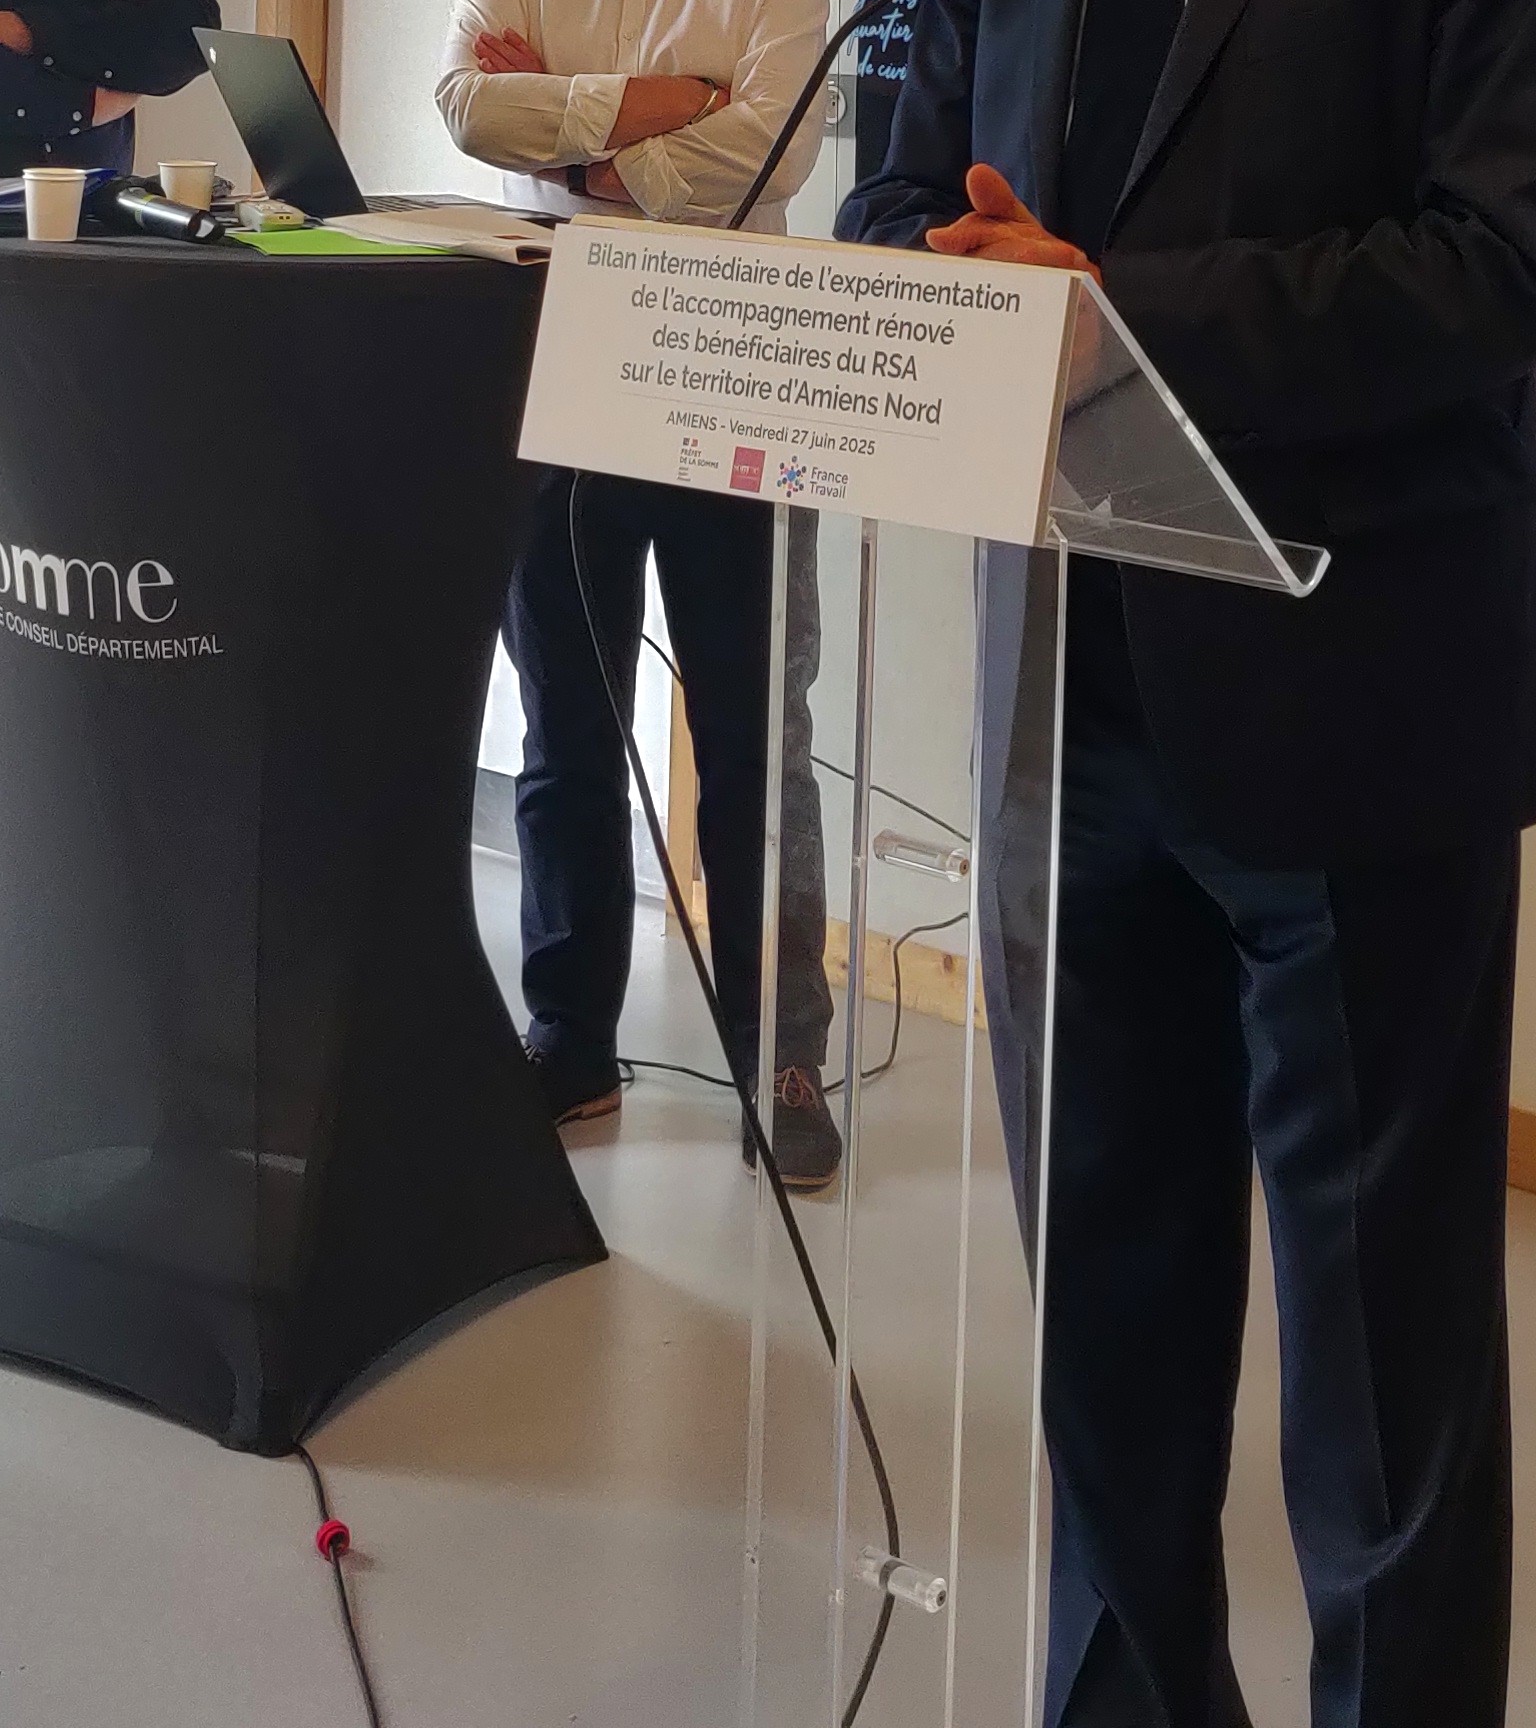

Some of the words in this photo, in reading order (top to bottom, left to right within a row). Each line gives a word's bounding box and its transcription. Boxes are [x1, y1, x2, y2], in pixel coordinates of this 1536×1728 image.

[858, 44, 874, 78] de
[587, 241, 637, 271] Bilan
[641, 247, 781, 286] intermédiaire
[785, 263, 814, 289] de
[818, 265, 1022, 314] l'expérimentation
[631, 284, 658, 309] de
[662, 285, 871, 336] l'accompagnement
[875, 312, 956, 346] rénové
[652, 323, 690, 351] des
[694, 327, 831, 370] bénéficiaires
[836, 346, 866, 375] du
[872, 350, 918, 382] RSA
[620, 361, 655, 384] sur
[656, 359, 677, 387] le
[682, 364, 772, 401] territoire
[777, 378, 879, 416] d'Amiens
[884, 392, 943, 425] Nord
[666, 410, 718, 432] AMIENS
[729, 419, 788, 443] Vendredi
[791, 428, 808, 445] 27
[808, 431, 836, 451] juin
[838, 435, 876, 455] 2025
[809, 481, 846, 499] Travail
[811, 466, 849, 485] France
[5, 610, 65, 650] CONSEIL
[66, 631, 224, 660] DÉPARTEMENTAL
